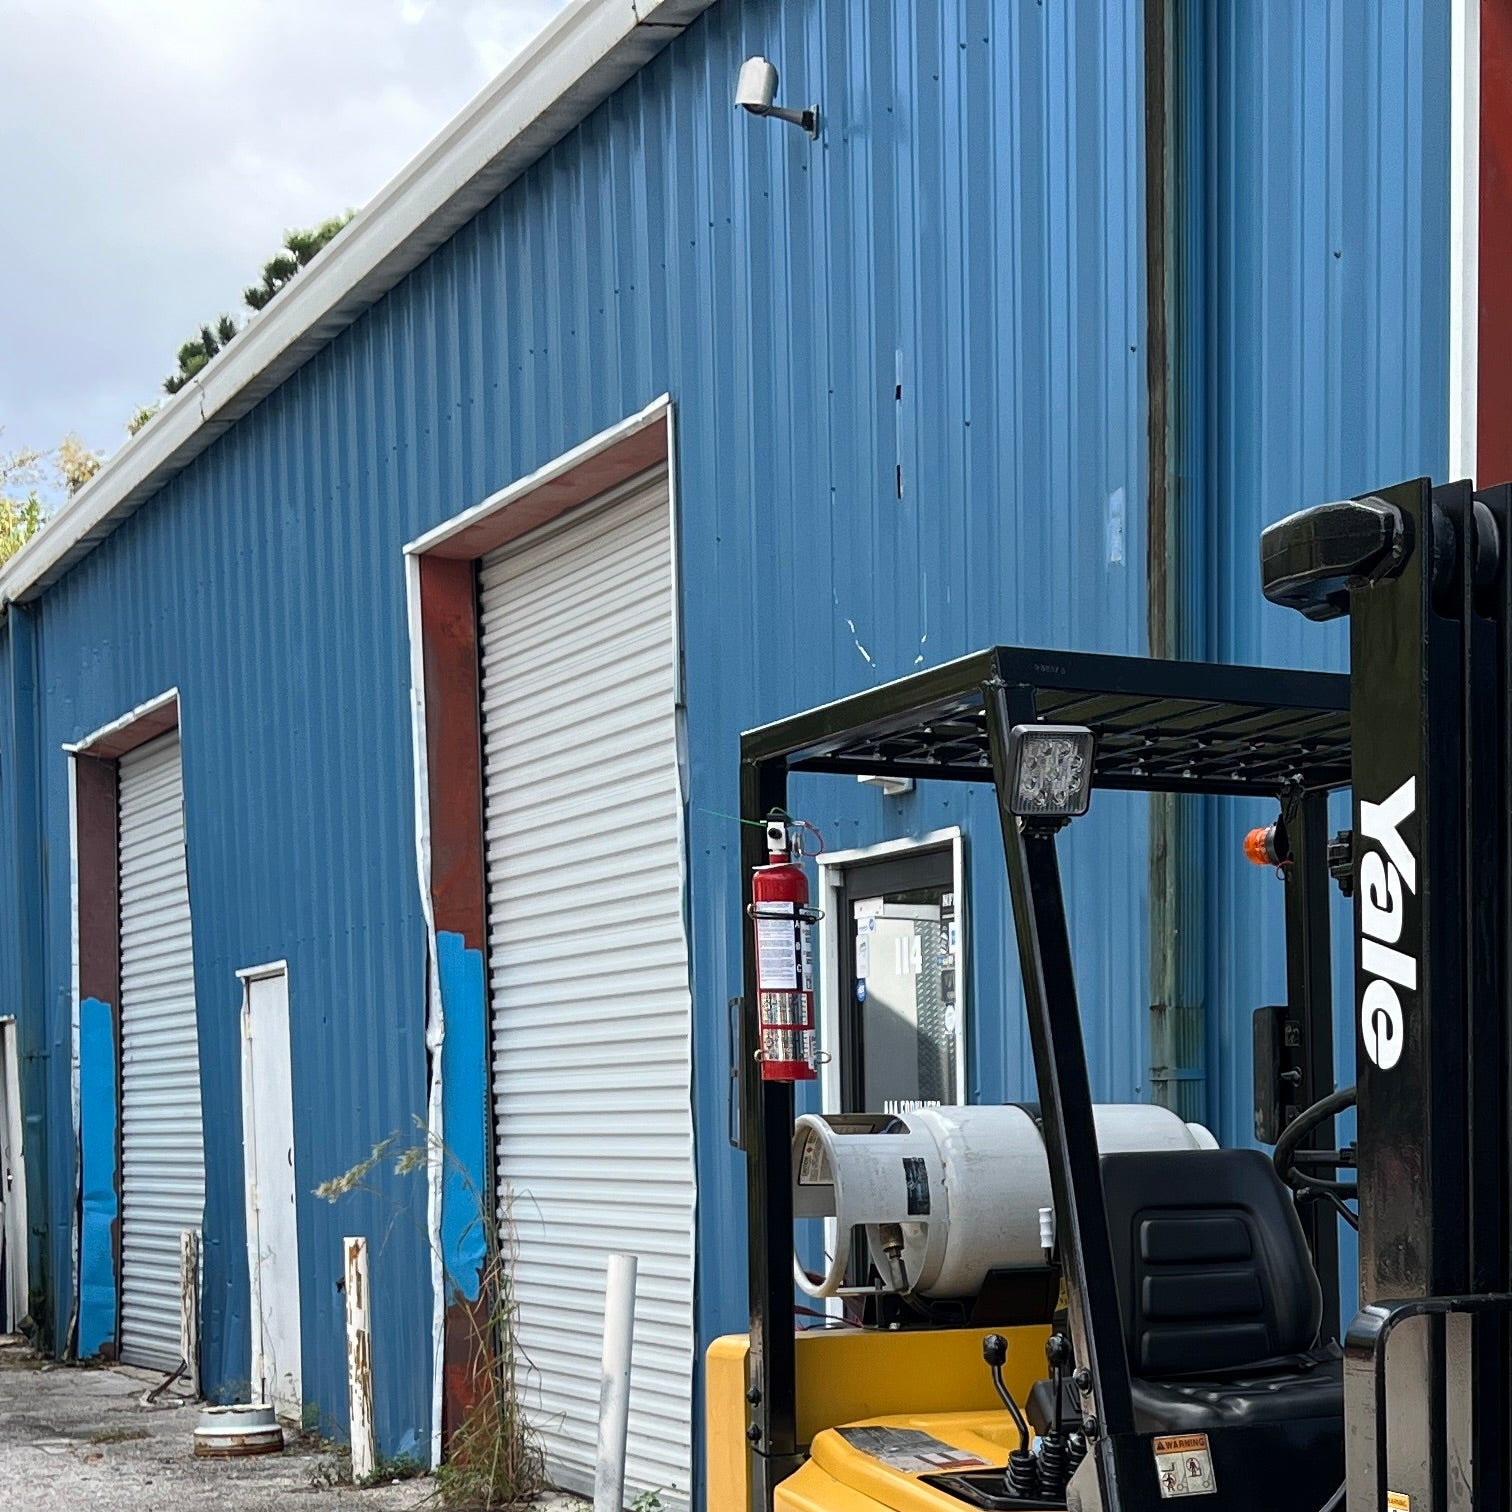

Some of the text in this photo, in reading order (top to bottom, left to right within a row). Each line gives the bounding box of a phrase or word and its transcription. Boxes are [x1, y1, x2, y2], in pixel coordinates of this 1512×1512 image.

[1360, 775, 1417, 1070] Yale
[895, 935, 922, 976] 114
[1165, 1438, 1205, 1450] WARNING
